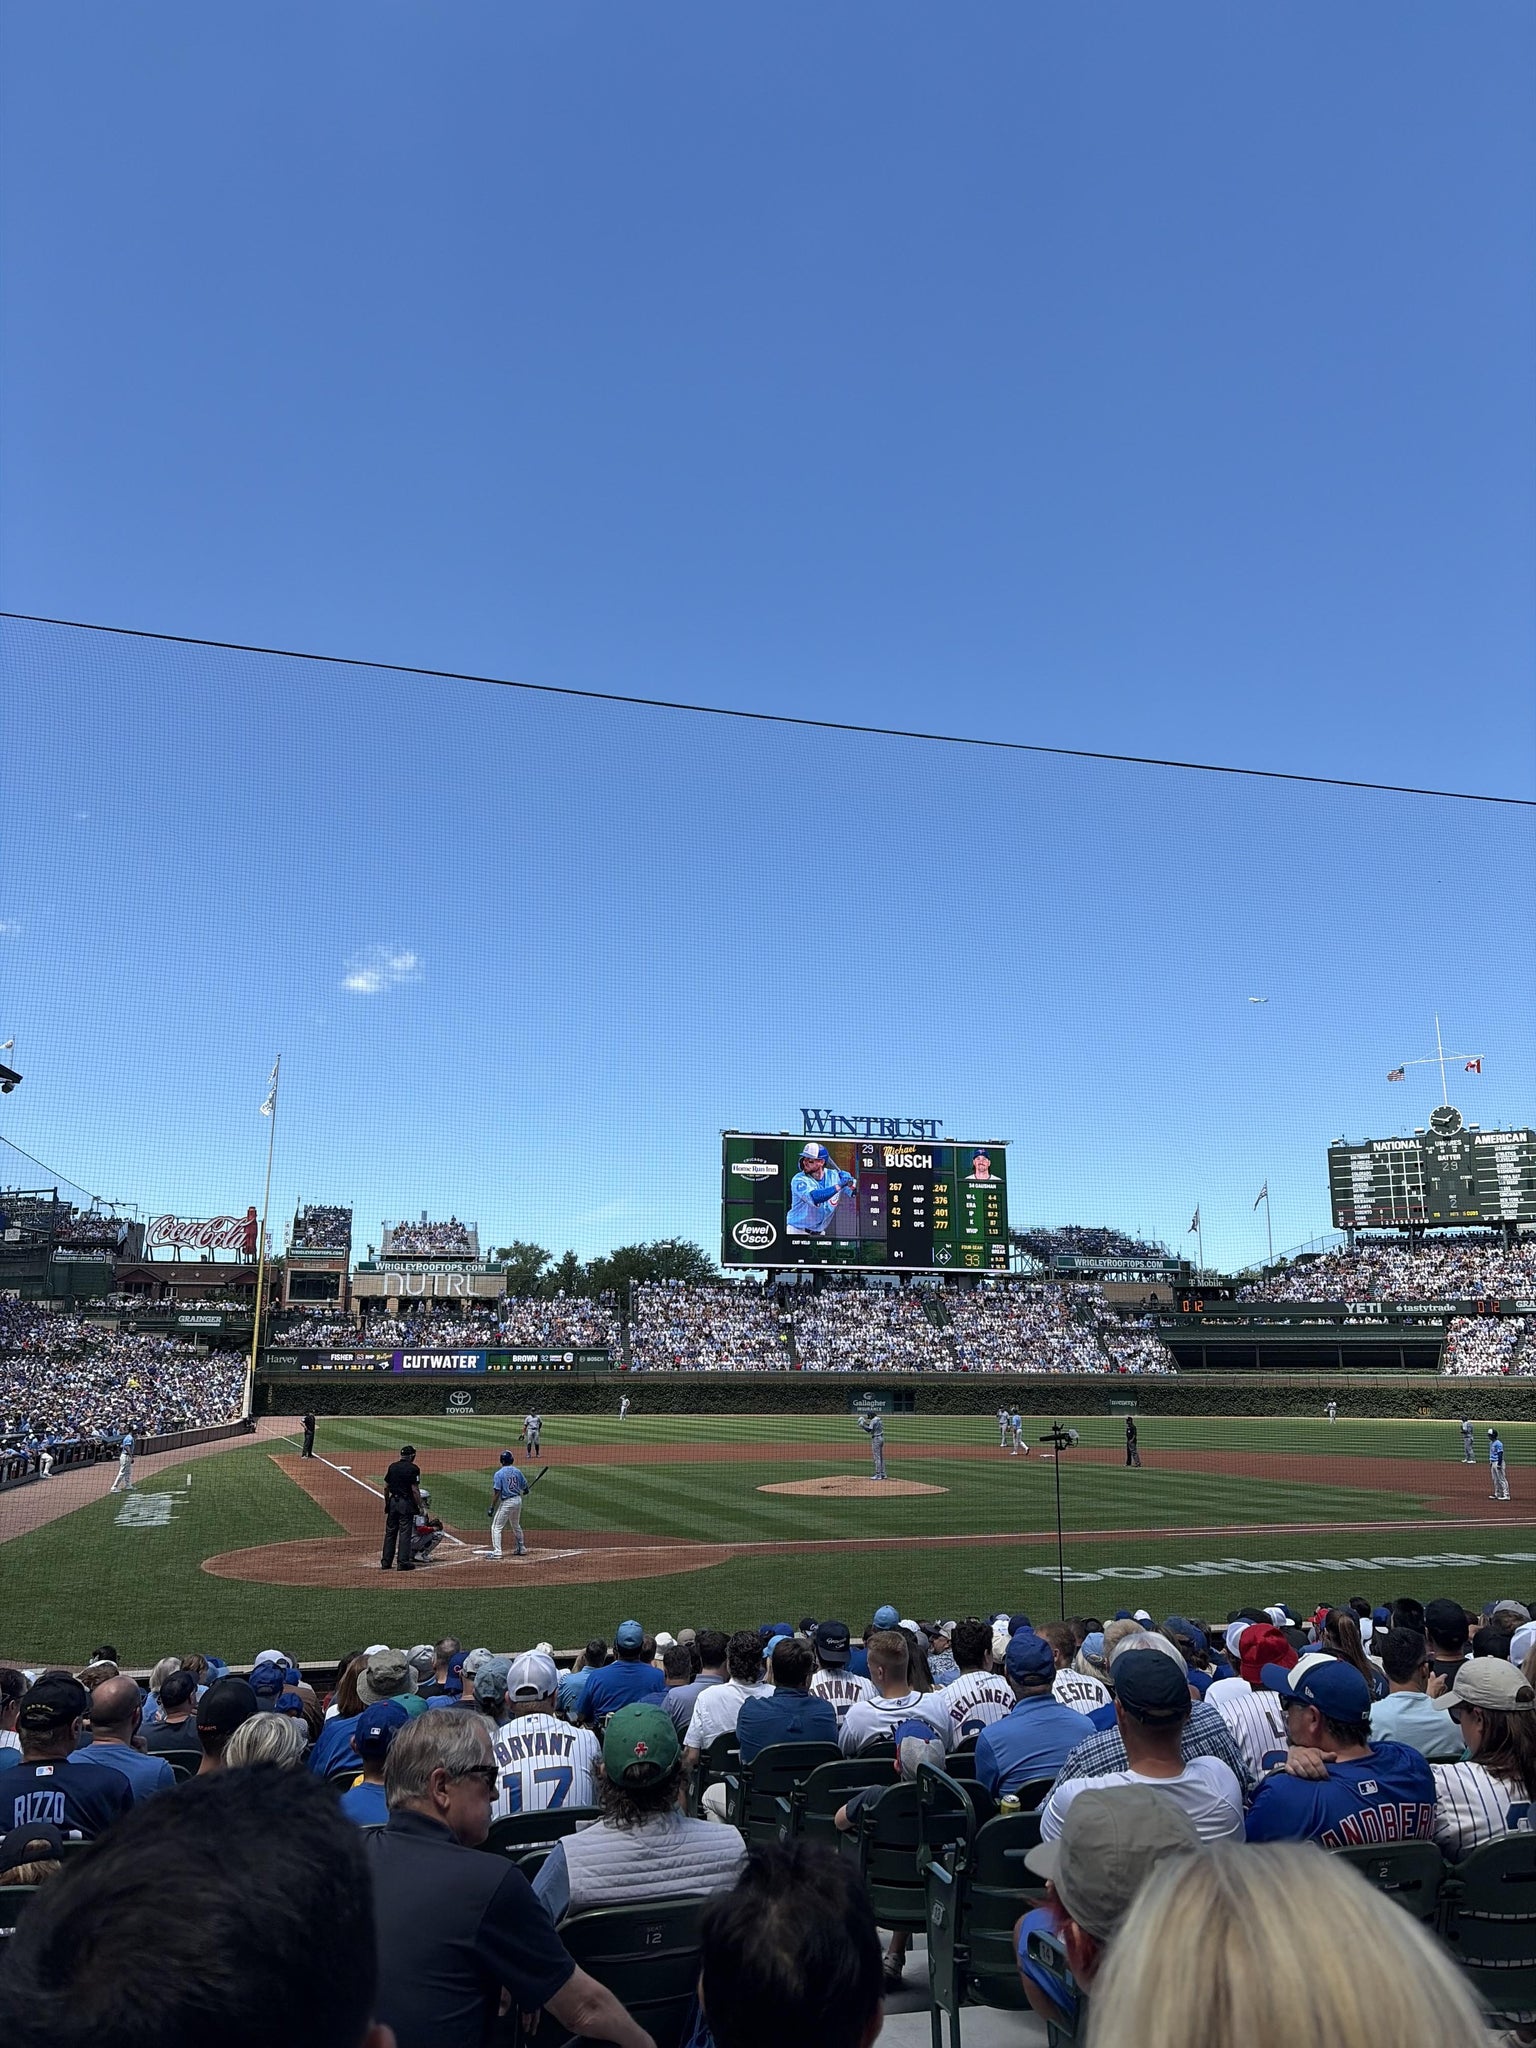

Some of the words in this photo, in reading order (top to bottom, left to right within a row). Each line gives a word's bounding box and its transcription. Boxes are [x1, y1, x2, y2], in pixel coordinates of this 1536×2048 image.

[800, 1109, 943, 1138] WINTRUST
[1475, 1132, 1528, 1144] AMERICAN
[862, 1144, 874, 1154] 29
[883, 1145, 916, 1156] Michael
[1373, 1140, 1422, 1151] NATIONAL
[862, 1158, 873, 1167] 1B
[886, 1154, 932, 1168] BUSCH
[1442, 1162, 1458, 1171] 29
[889, 1183, 902, 1191] 267
[933, 1197, 948, 1205] .376
[1450, 1199, 1457, 1208] 2
[933, 1209, 948, 1217] .401
[738, 1224, 769, 1234] Jewel
[892, 1220, 901, 1228] 31
[147, 1214, 254, 1250] Coca-Cola
[740, 1234, 770, 1243] Osco.
[965, 1254, 980, 1266] 93
[1074, 1258, 1163, 1268] WRIGLEYROOFTOPS.COM
[375, 1262, 486, 1272] WRIGLEYROOFTOPS.COM
[1344, 1303, 1382, 1313] YETI
[1403, 1304, 1456, 1313] tastytrade
[266, 1355, 297, 1365] Harvey
[403, 1355, 477, 1369] CUTWATER
[507, 1476, 519, 1490] 29
[1023, 1553, 1519, 1582] Southwest
[1056, 1683, 1104, 1704] ESTER
[495, 1733, 576, 1768] BRYANT
[502, 1766, 573, 1814] 17
[14, 1792, 65, 1828] RIZZO
[1380, 1868, 1388, 1877] 2
[646, 1933, 662, 1944] 12
